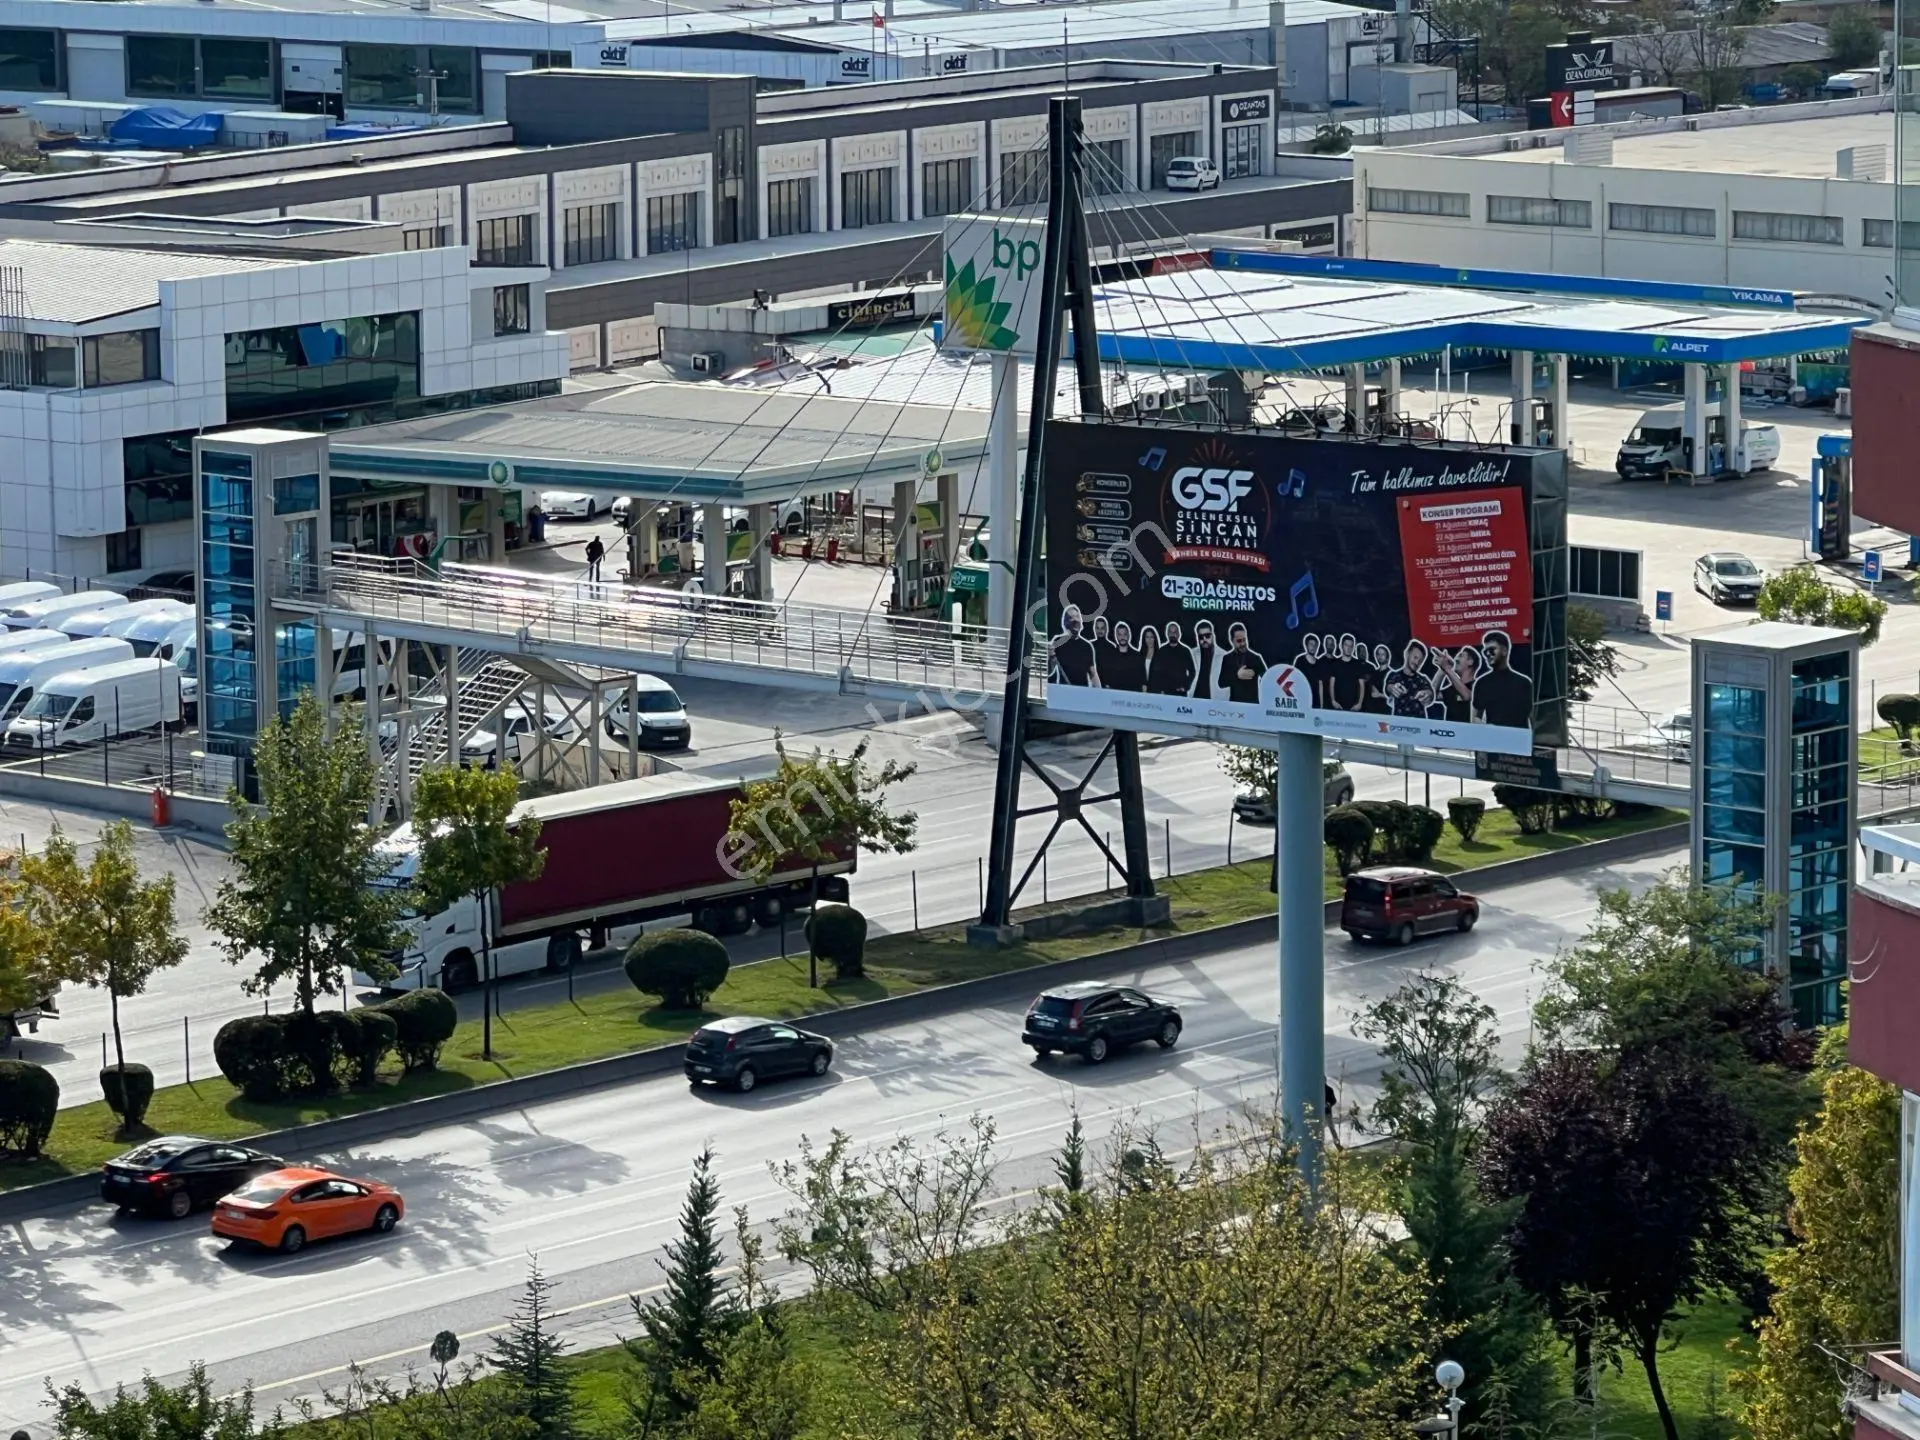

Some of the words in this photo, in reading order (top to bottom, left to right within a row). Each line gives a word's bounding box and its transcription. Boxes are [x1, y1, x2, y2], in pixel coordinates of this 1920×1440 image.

[1565, 69, 1583, 80] OZAN
[993, 227, 1041, 281] bp
[1732, 291, 1784, 303] YIKAMA
[1671, 342, 1710, 353] ALPET
[1351, 470, 1376, 494] Tüm
[1382, 467, 1434, 490] halkımız
[1439, 459, 1511, 486] davetlidir!
[1171, 466, 1254, 512] GSF
[1177, 511, 1256, 524] GELENEKSEL
[1422, 509, 1454, 519] KONSER
[1456, 504, 1500, 515] PROGRAMI
[1200, 549, 1210, 557] EN
[1236, 552, 1266, 566] HAFTASI
[1164, 579, 1203, 596] 21-30
[1206, 579, 1276, 602] AĞUSTOS
[1225, 600, 1256, 611] PARK
[1208, 708, 1246, 719] ONYX
